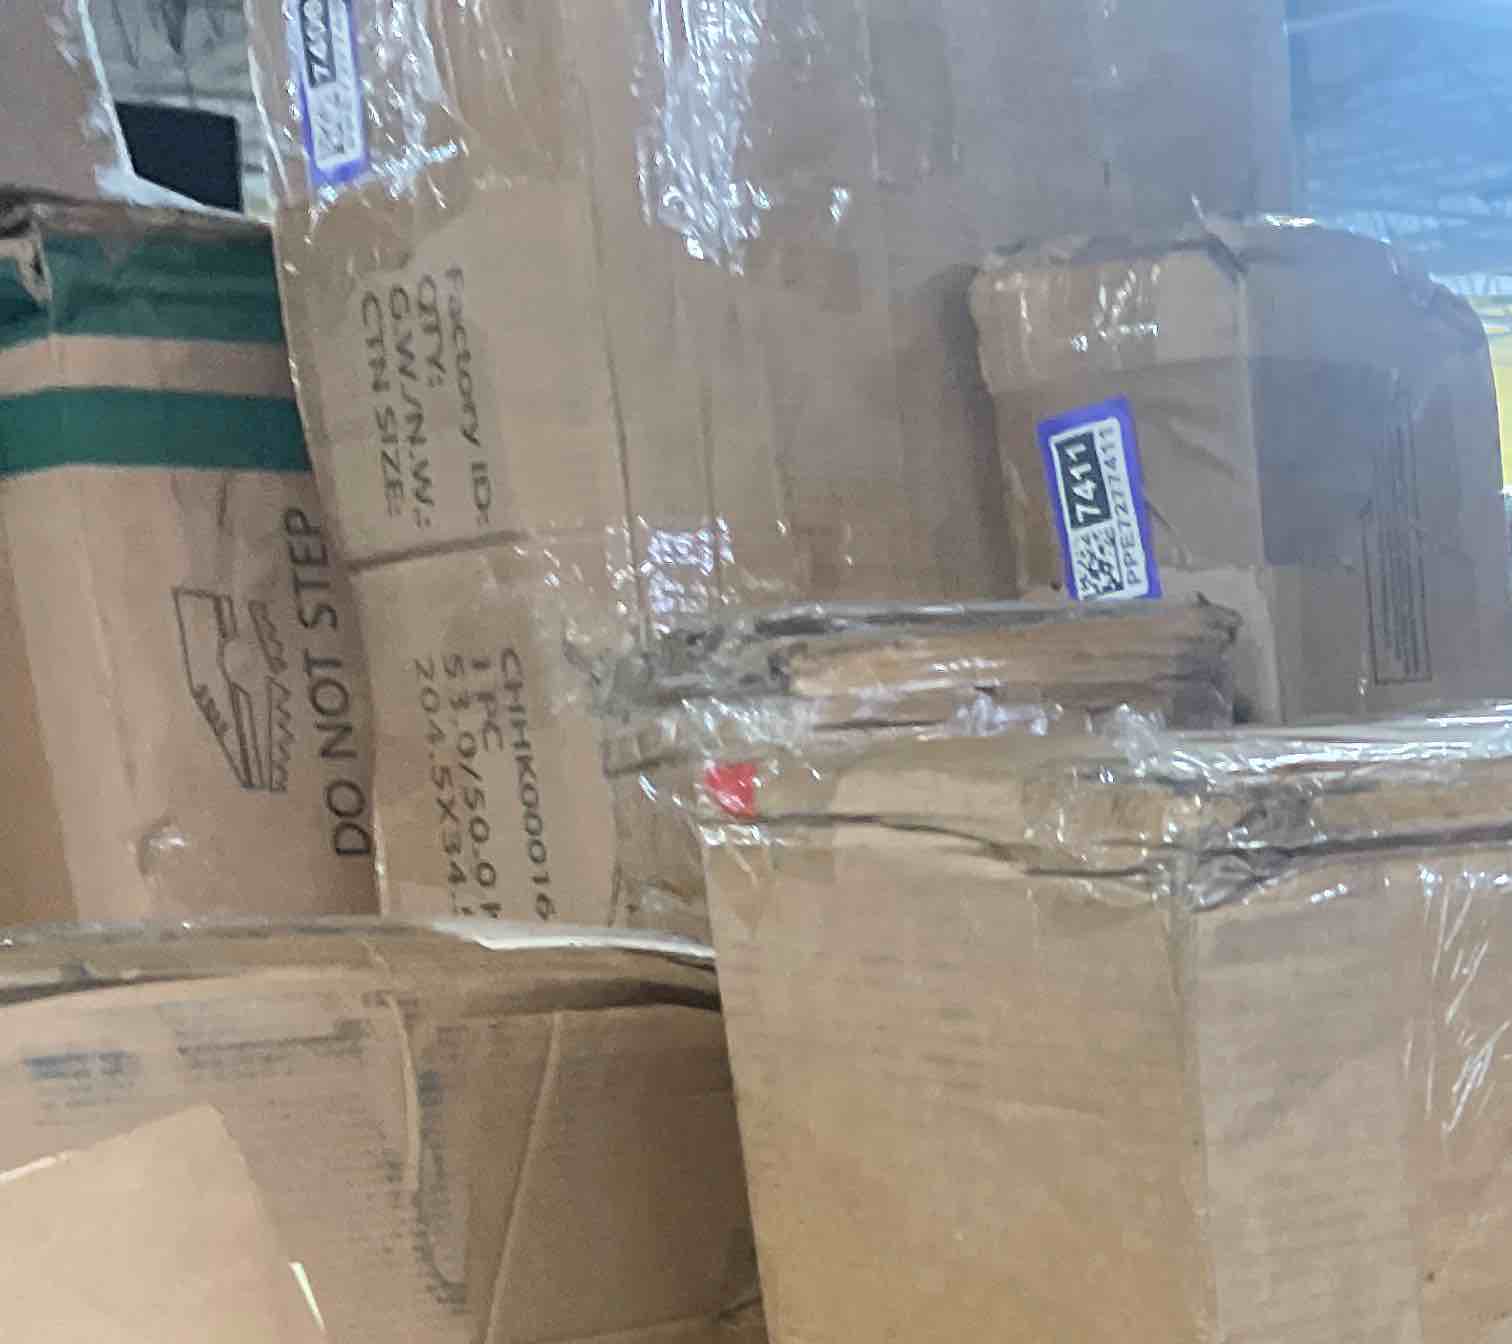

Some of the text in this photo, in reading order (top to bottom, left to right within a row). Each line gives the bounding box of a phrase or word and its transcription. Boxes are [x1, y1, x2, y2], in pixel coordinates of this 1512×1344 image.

[362, 291, 391, 392] CTN
[445, 268, 481, 447] Factory
[1063, 442, 1102, 524] 7411
[284, 507, 371, 856] DO NOT STEP
